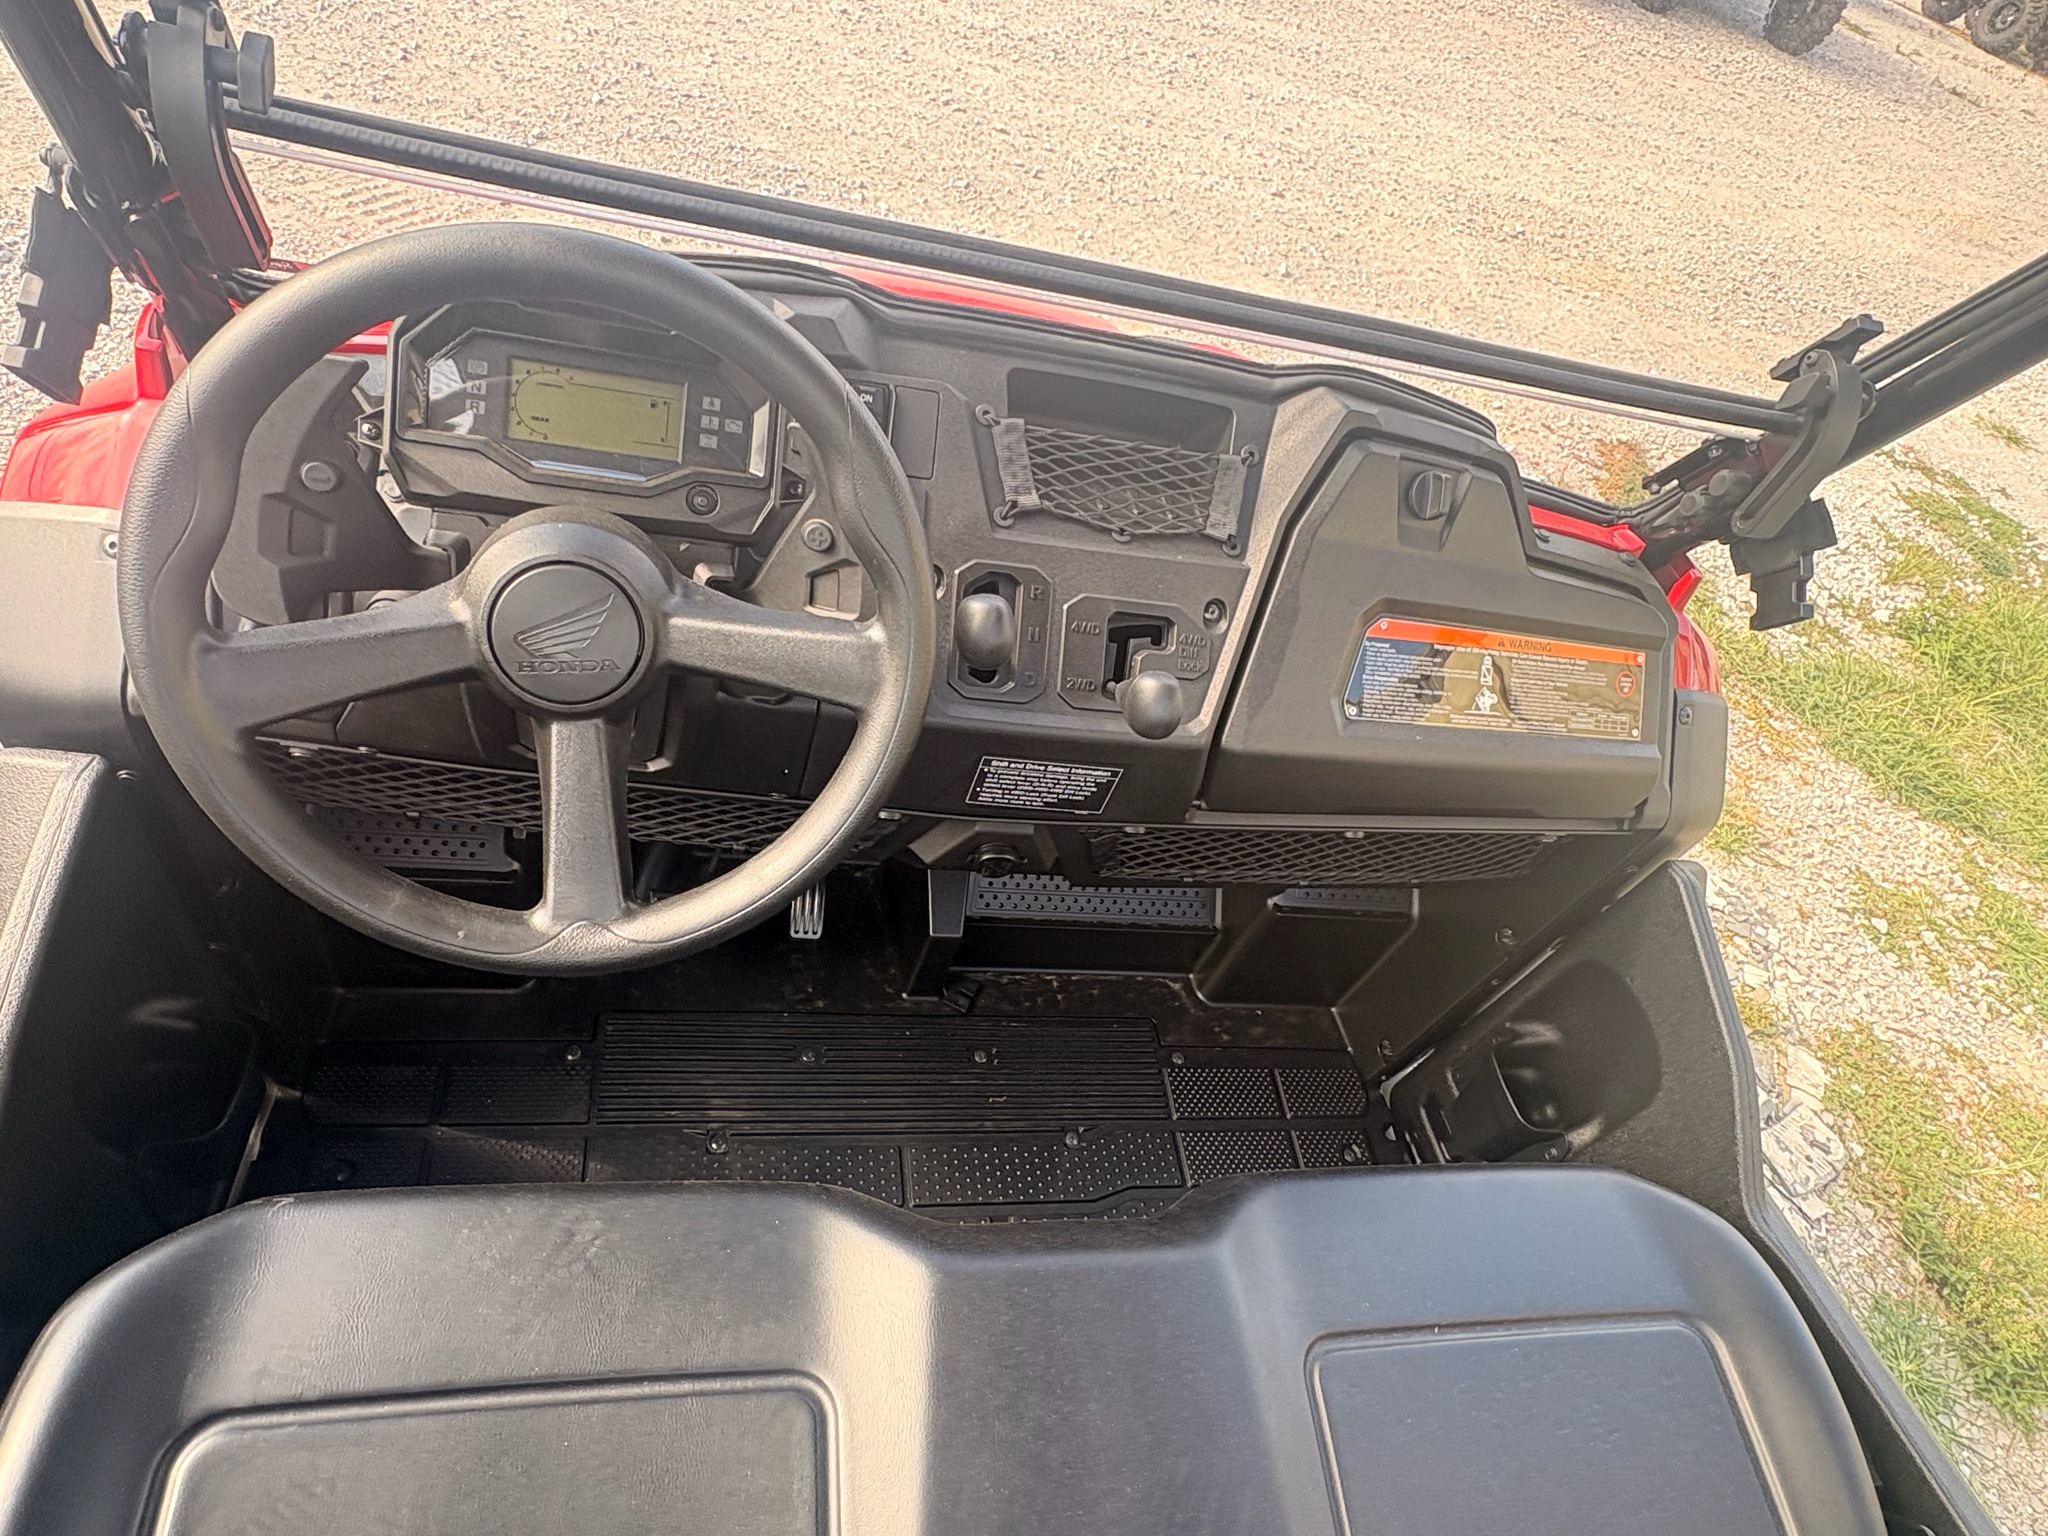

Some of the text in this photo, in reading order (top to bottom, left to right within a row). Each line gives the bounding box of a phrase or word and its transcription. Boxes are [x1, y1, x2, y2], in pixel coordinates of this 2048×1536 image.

[471, 381, 481, 393] N
[860, 393, 873, 403] ON
[470, 401, 480, 413] R
[1030, 584, 1043, 600] R
[1027, 626, 1040, 642] N
[1071, 620, 1100, 635] 4WD
[1179, 633, 1206, 647] 4WD
[1508, 638, 1552, 652] WARNING
[515, 659, 622, 674] HONDA
[1178, 659, 1203, 671] Lock
[1066, 677, 1096, 692] 2WD
[1046, 765, 1070, 773] Select
[1070, 768, 1111, 776] Information
